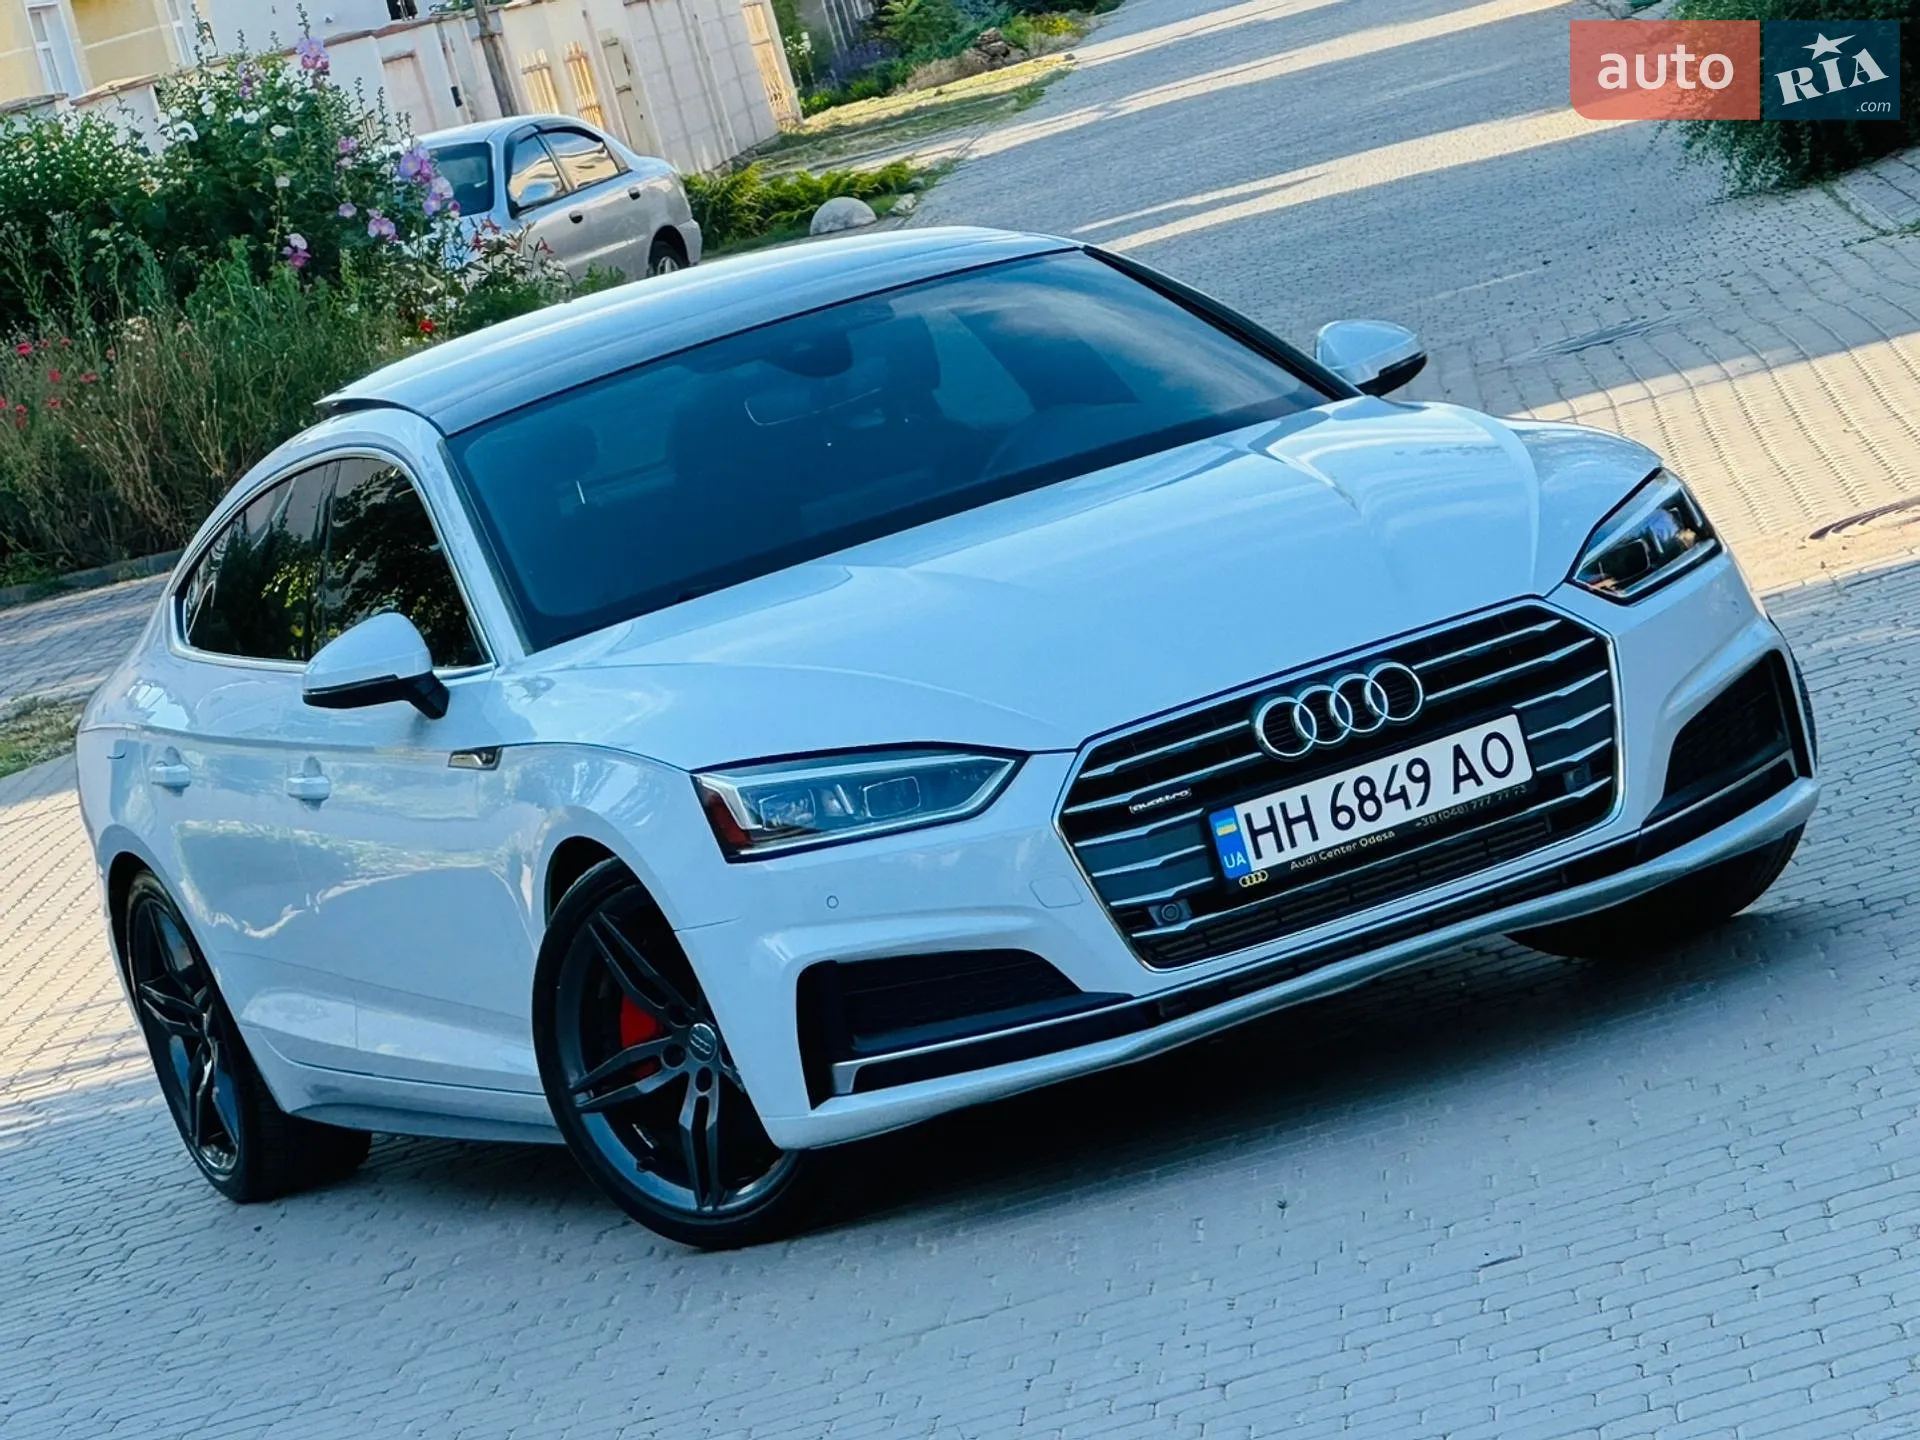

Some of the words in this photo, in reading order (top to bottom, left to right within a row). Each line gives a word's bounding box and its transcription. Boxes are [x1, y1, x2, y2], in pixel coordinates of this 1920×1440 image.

[1244, 794, 1319, 860] HH
[1330, 757, 1431, 831] 6849
[1453, 731, 1514, 795] AO
[1223, 851, 1247, 869] UA
[1290, 854, 1318, 870] Audi
[1319, 841, 1358, 860] Center
